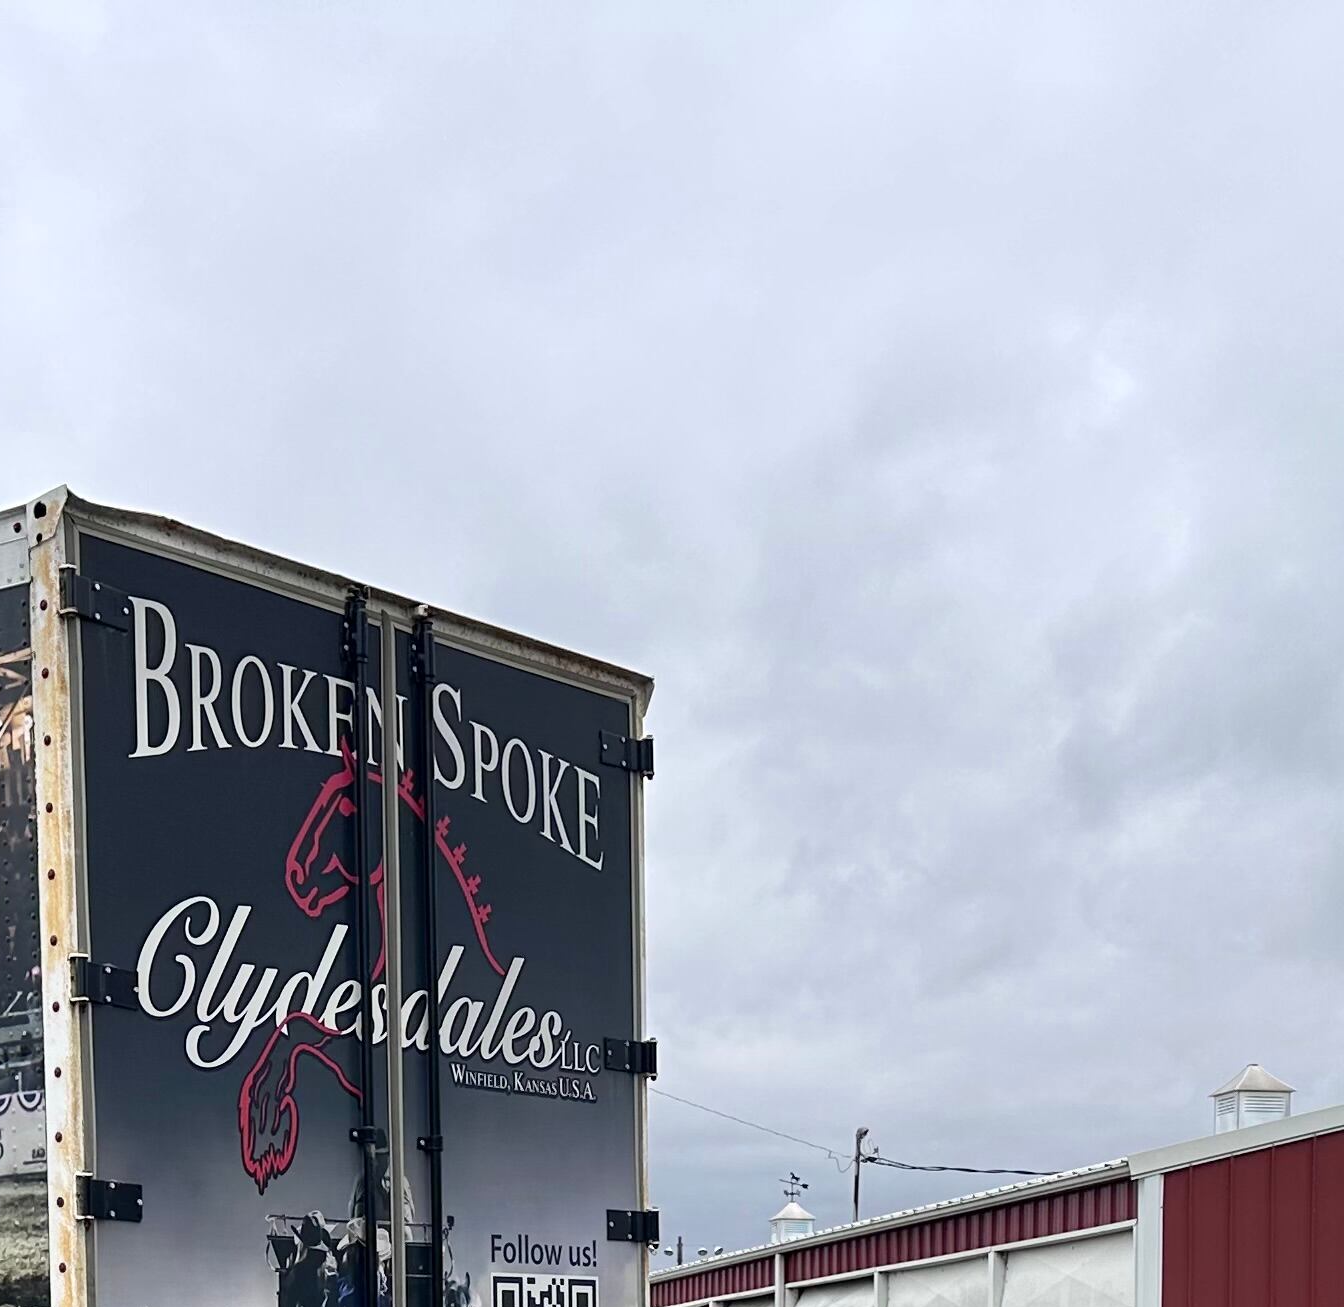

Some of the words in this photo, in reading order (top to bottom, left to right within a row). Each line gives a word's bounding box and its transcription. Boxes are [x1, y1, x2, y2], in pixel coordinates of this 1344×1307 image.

[128, 596, 408, 772] BROKEN
[432, 682, 604, 871] SPOKE
[136, 896, 563, 1069] Clydesdales
[560, 1038, 600, 1073] LLC
[450, 1063, 511, 1091] WINFIELD,
[514, 1072, 557, 1096] KANSAS
[491, 1234, 562, 1266] Follow
[569, 1240, 597, 1268] us!
